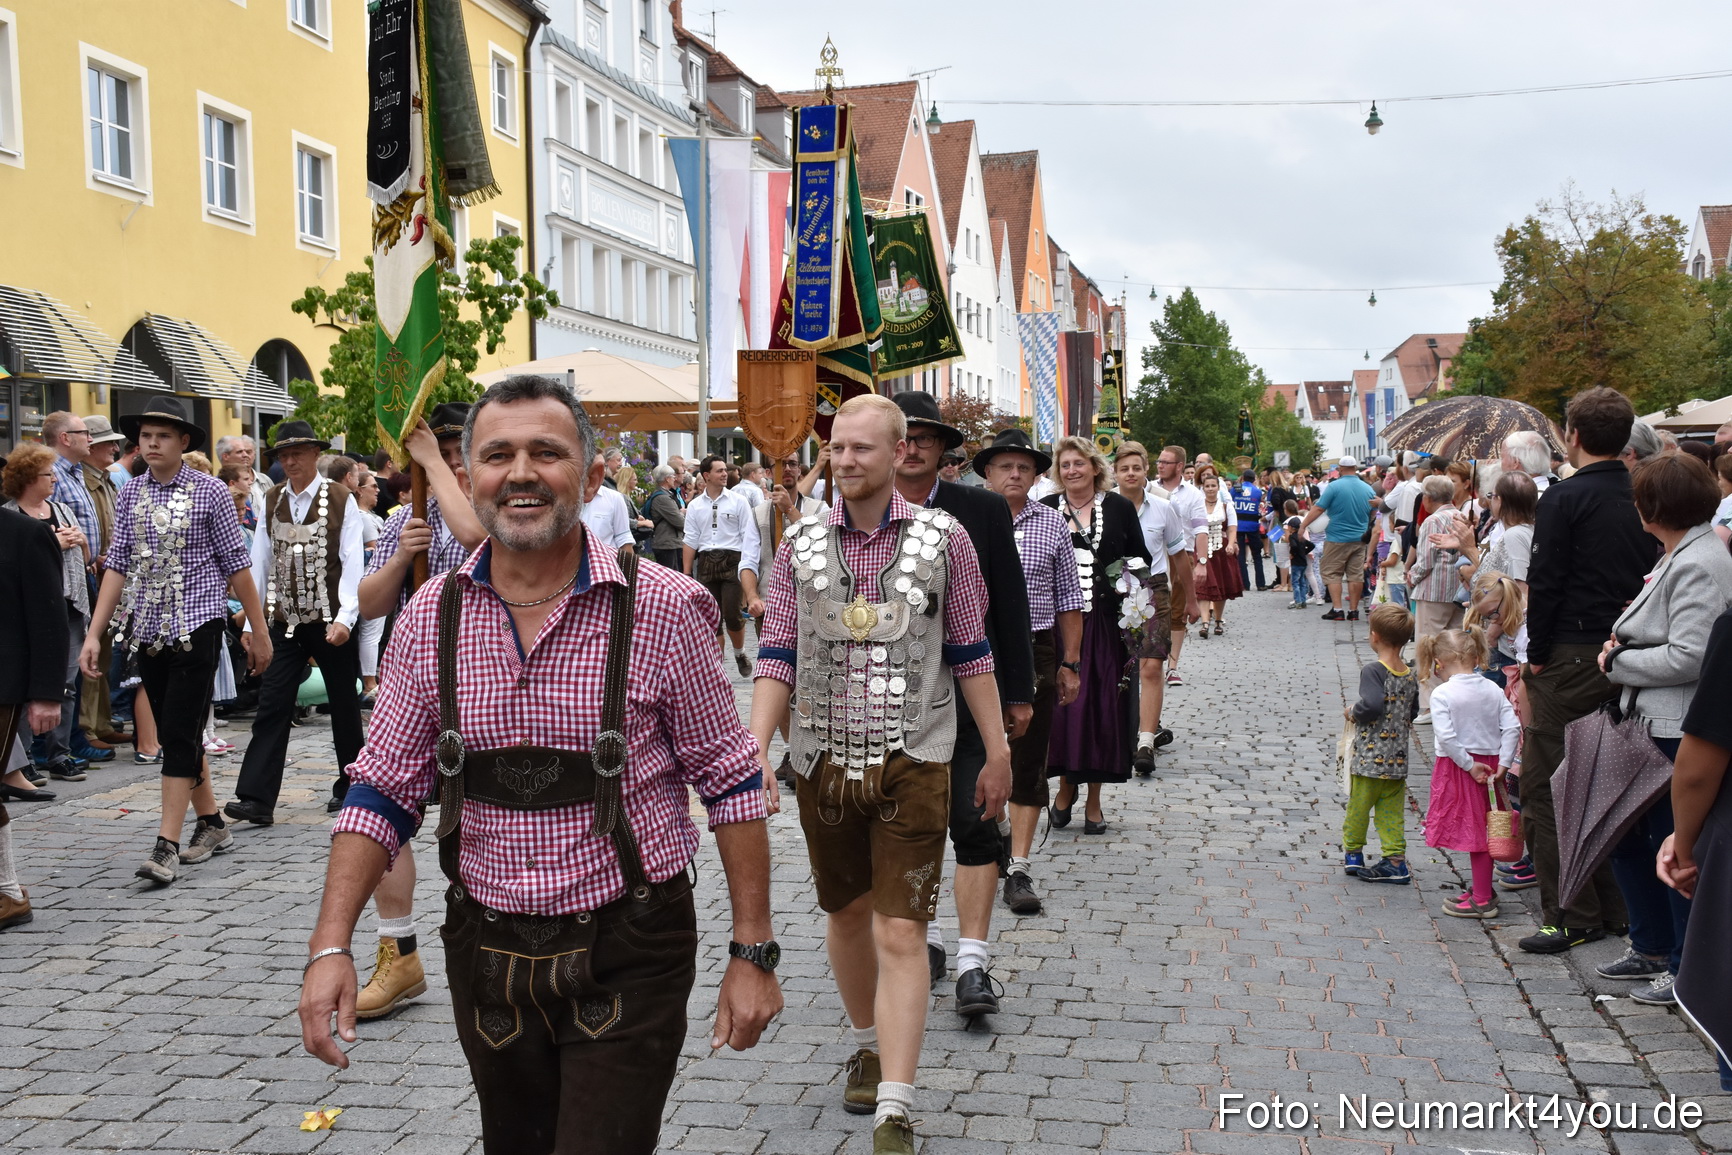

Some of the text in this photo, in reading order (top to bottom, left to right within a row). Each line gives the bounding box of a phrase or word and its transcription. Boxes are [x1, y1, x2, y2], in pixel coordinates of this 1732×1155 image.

[798, 195, 831, 247] Fahnenbraut
[740, 350, 813, 362] REICHERTSHOFEN
[1234, 501, 1256, 511] LIVE
